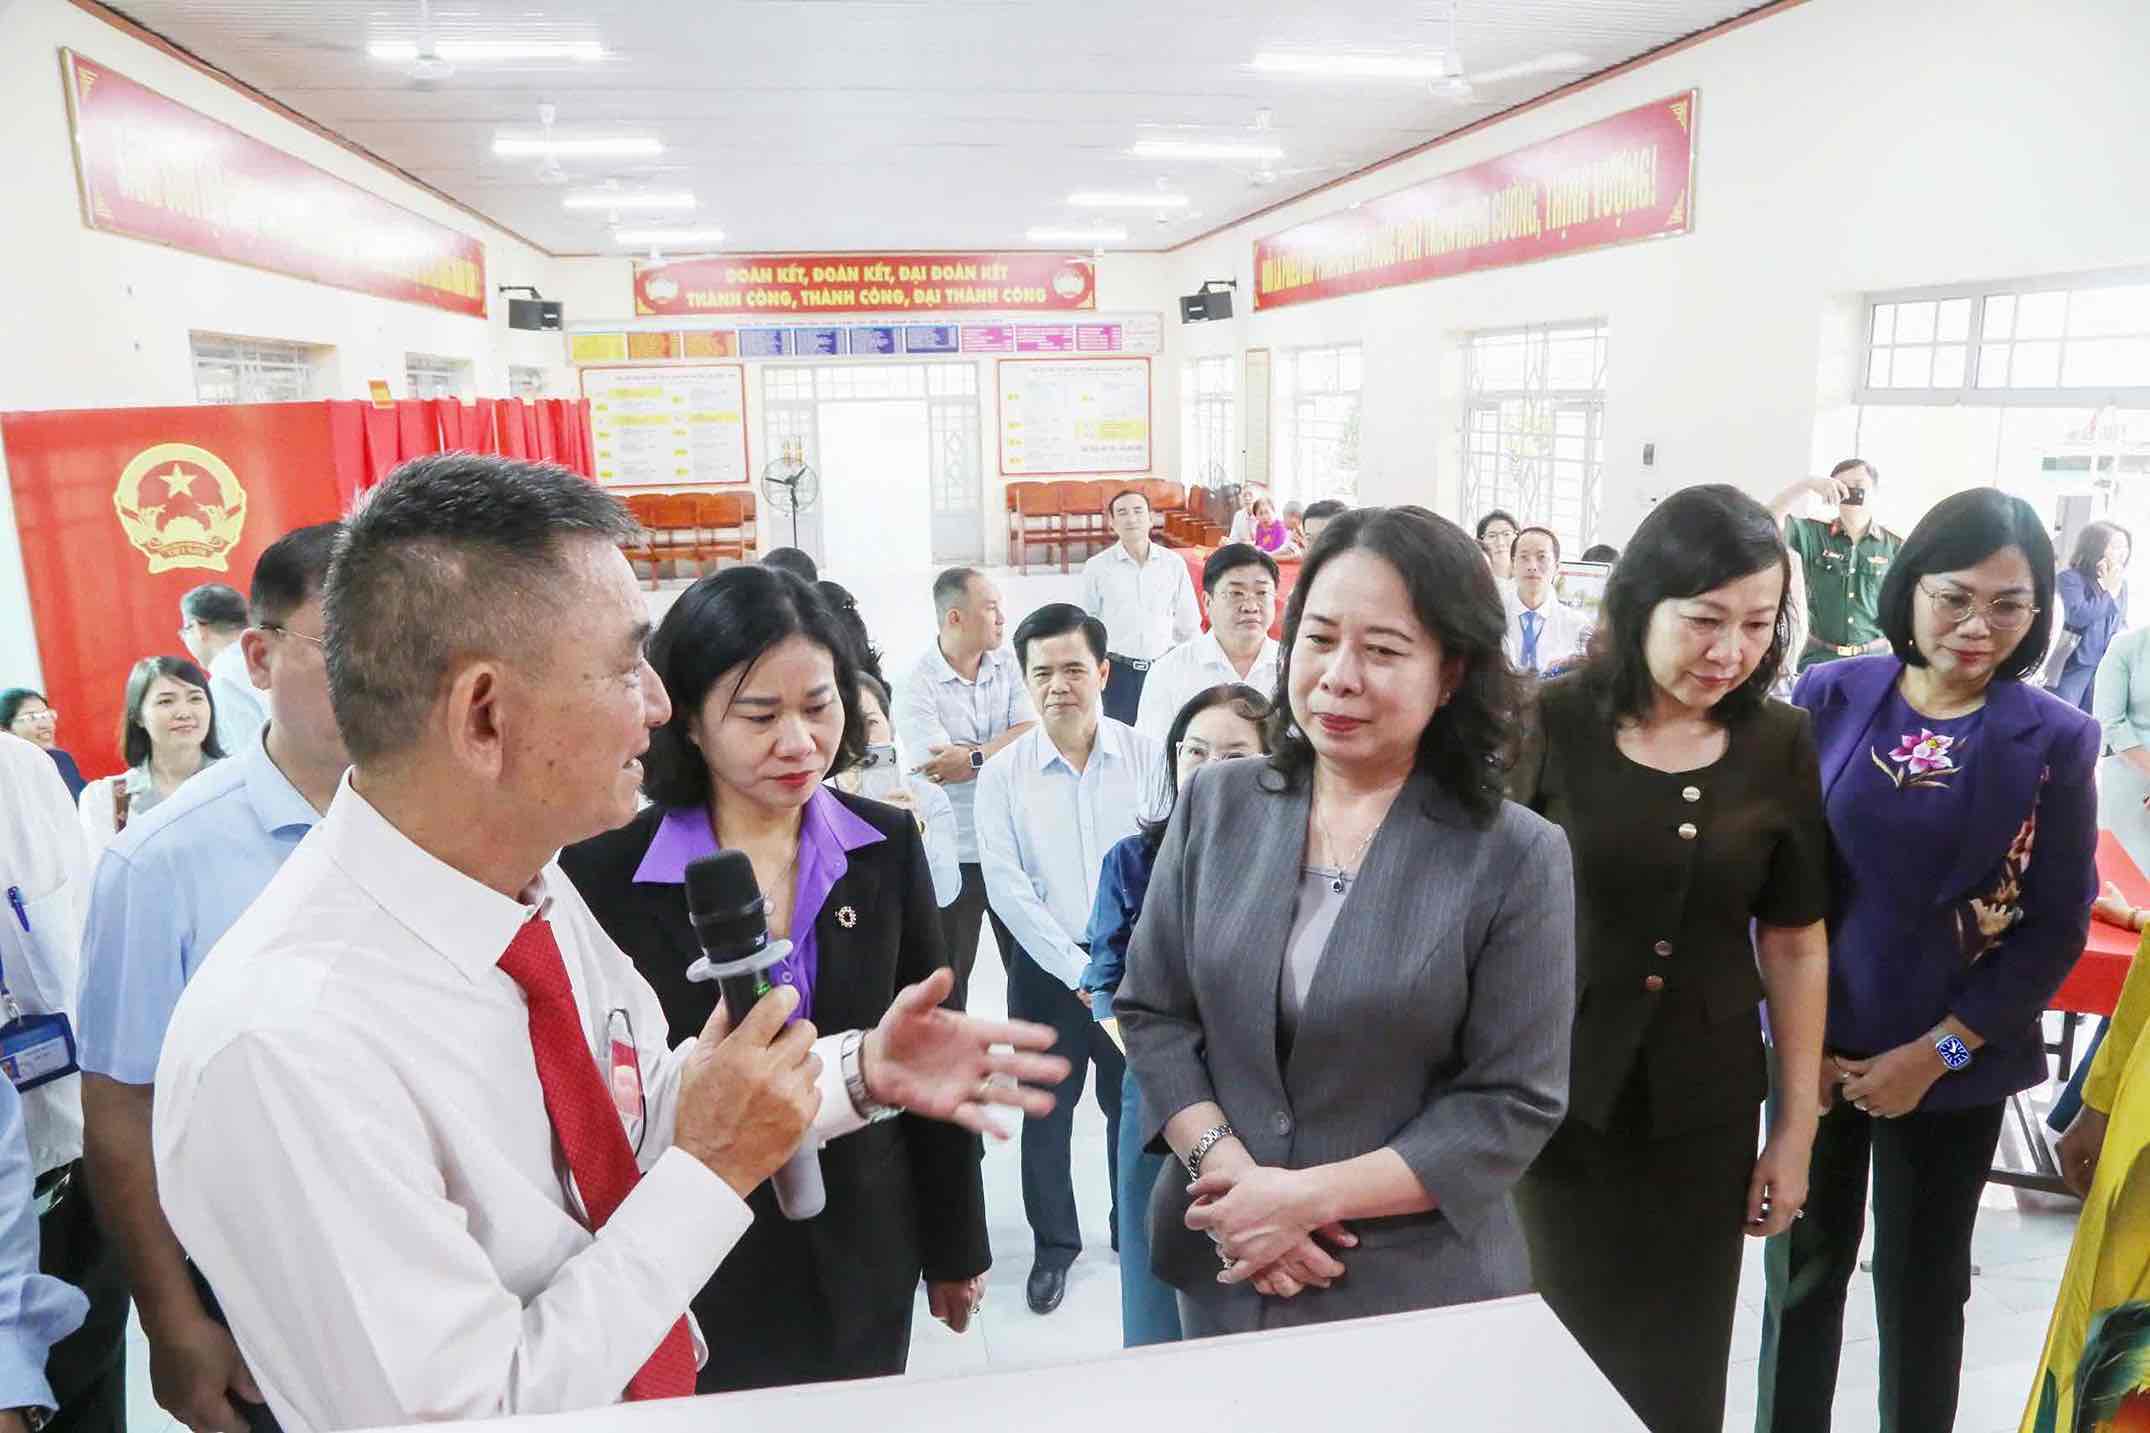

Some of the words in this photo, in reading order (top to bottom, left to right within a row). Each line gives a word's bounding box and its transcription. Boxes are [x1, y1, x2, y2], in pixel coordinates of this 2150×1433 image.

[778, 263, 809, 285] KẾT,
[812, 264, 859, 282] ĐOÀN
[864, 262, 895, 284] KẾT,
[899, 265, 927, 284] ĐẠI
[931, 263, 976, 281] ĐOÀN
[686, 287, 741, 307] THÀNH
[747, 287, 797, 308] CÔNG,
[800, 286, 855, 305] THÀNH
[860, 285, 909, 307] CÔNG,
[913, 288, 941, 307] ĐẠI
[945, 285, 998, 304] THÀNH
[1003, 285, 1046, 303] CÔNG
